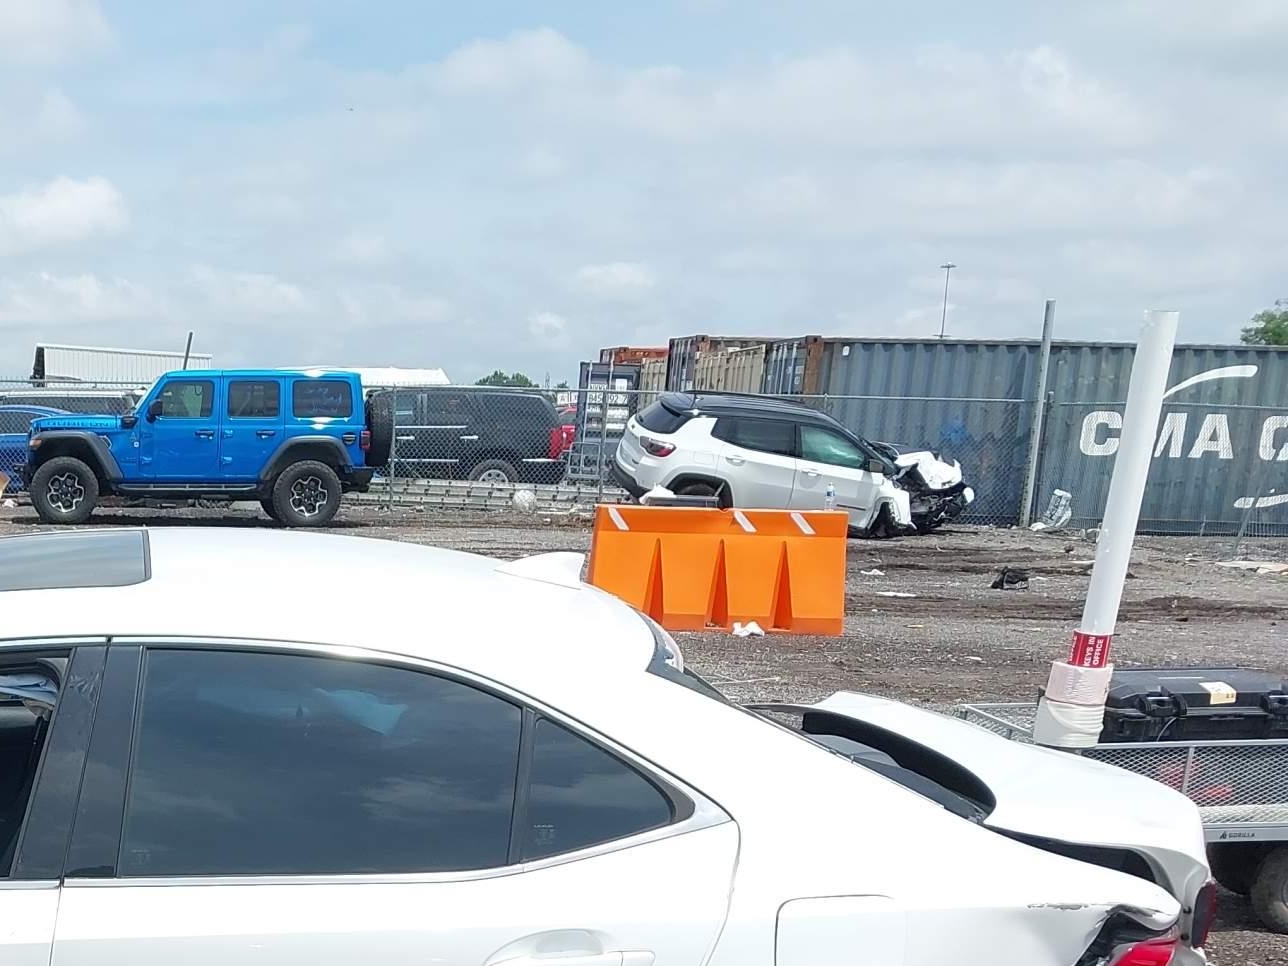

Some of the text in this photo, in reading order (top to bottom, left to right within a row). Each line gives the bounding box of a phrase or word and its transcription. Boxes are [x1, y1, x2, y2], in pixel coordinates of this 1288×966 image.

[1083, 636, 1096, 667] KEYS IN
[1092, 639, 1104, 666] OFFICE
